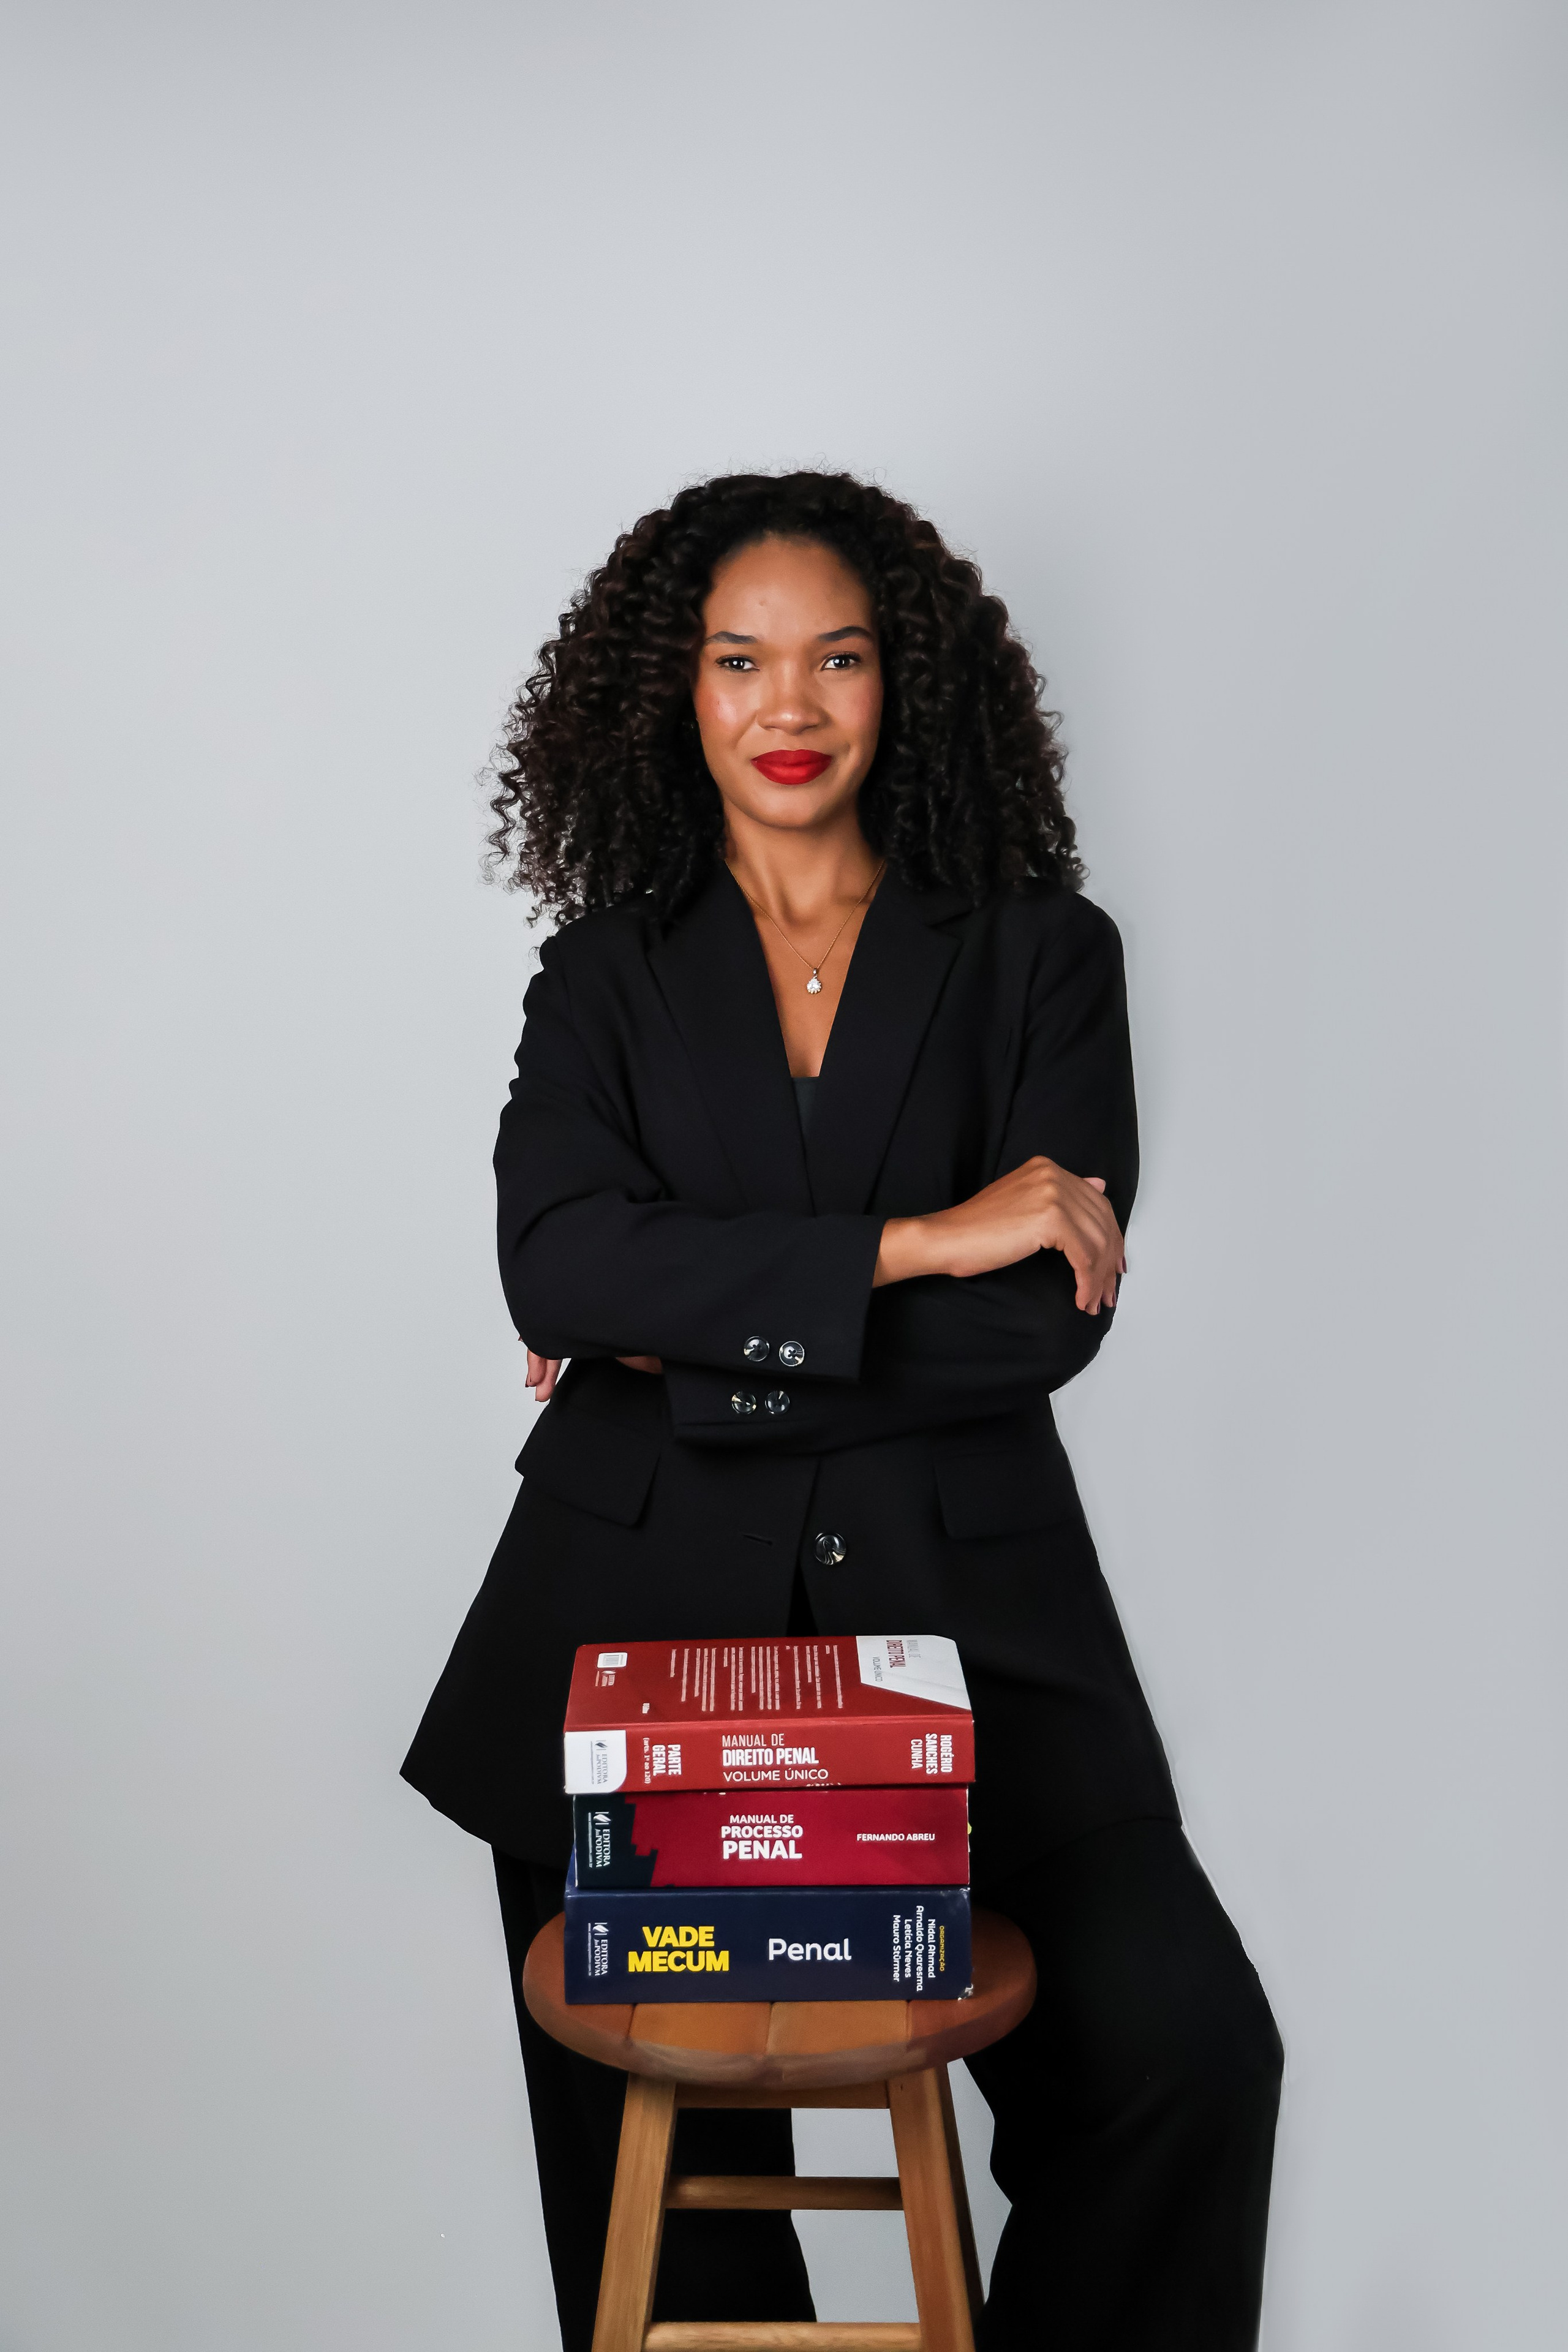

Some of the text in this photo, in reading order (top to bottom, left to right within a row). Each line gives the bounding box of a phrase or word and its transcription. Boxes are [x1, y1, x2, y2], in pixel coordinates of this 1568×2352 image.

[886, 1640, 906, 1668] DIREITO PENAL
[722, 1733, 785, 1747] MANUAL DE
[652, 1744, 666, 1776] GERAL
[668, 1744, 682, 1776] PARTE
[722, 1747, 819, 1766] DIREITO PENAL
[910, 1739, 923, 1769] CUNHA
[925, 1733, 938, 1774] SANCHES
[940, 1735, 954, 1773] ROGÉRIO
[723, 1768, 829, 1782] VOLUME ÚNICO
[729, 1814, 794, 1824] MANUAL DE
[721, 1825, 803, 1838] PROCESSO
[723, 1840, 802, 1860] PENAL
[642, 1926, 714, 1947] VADE
[769, 1938, 852, 1961] Penal
[628, 1950, 729, 1972] MECUM
[914, 1943, 924, 1992] Quaresma
